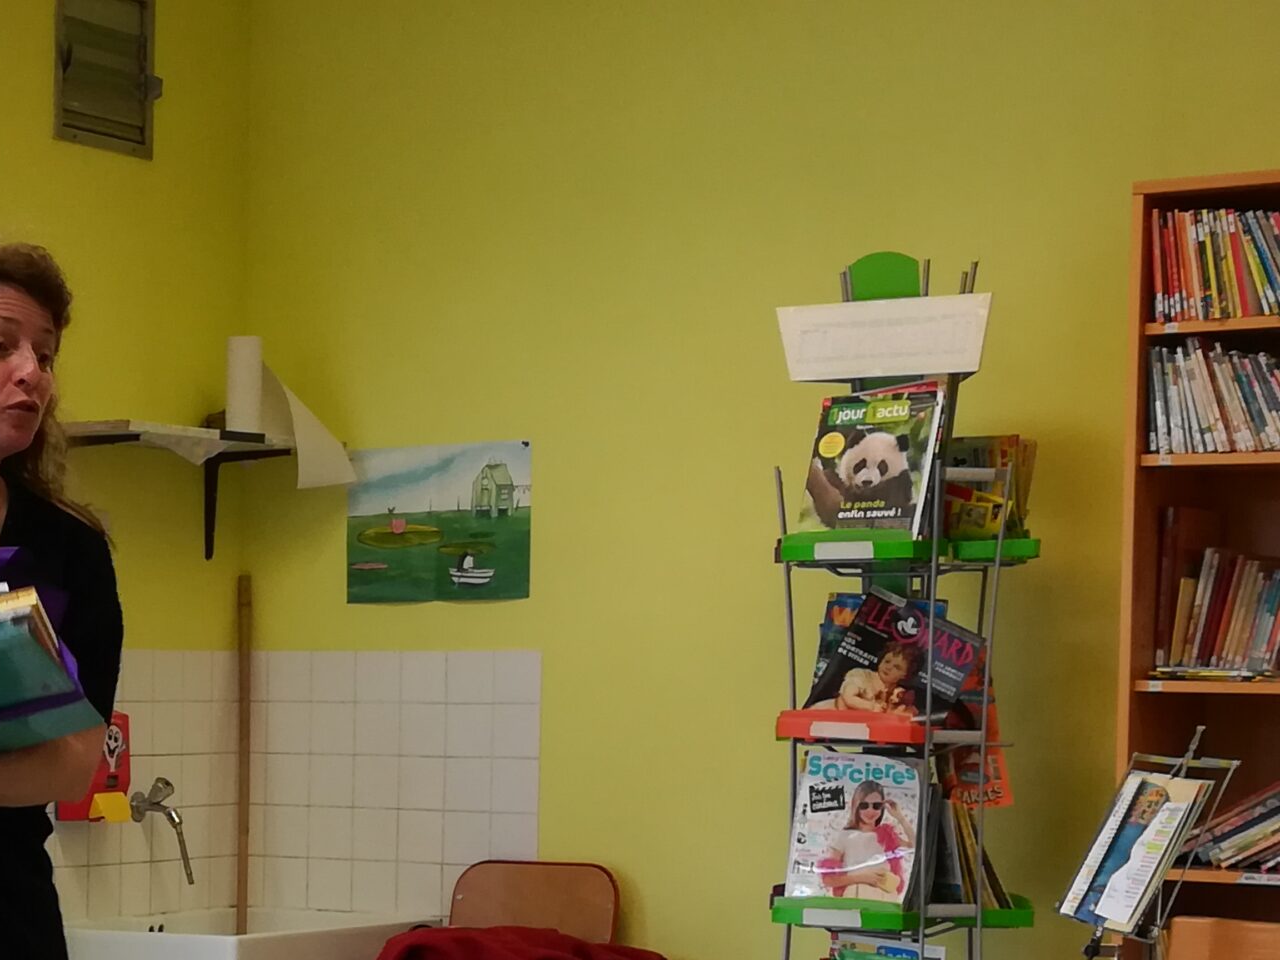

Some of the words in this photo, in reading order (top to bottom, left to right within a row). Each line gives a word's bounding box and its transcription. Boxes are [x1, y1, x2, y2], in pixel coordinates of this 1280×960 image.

[853, 499, 886, 509] panda
[837, 510, 865, 519] enfin
[866, 507, 896, 518] sauvé
